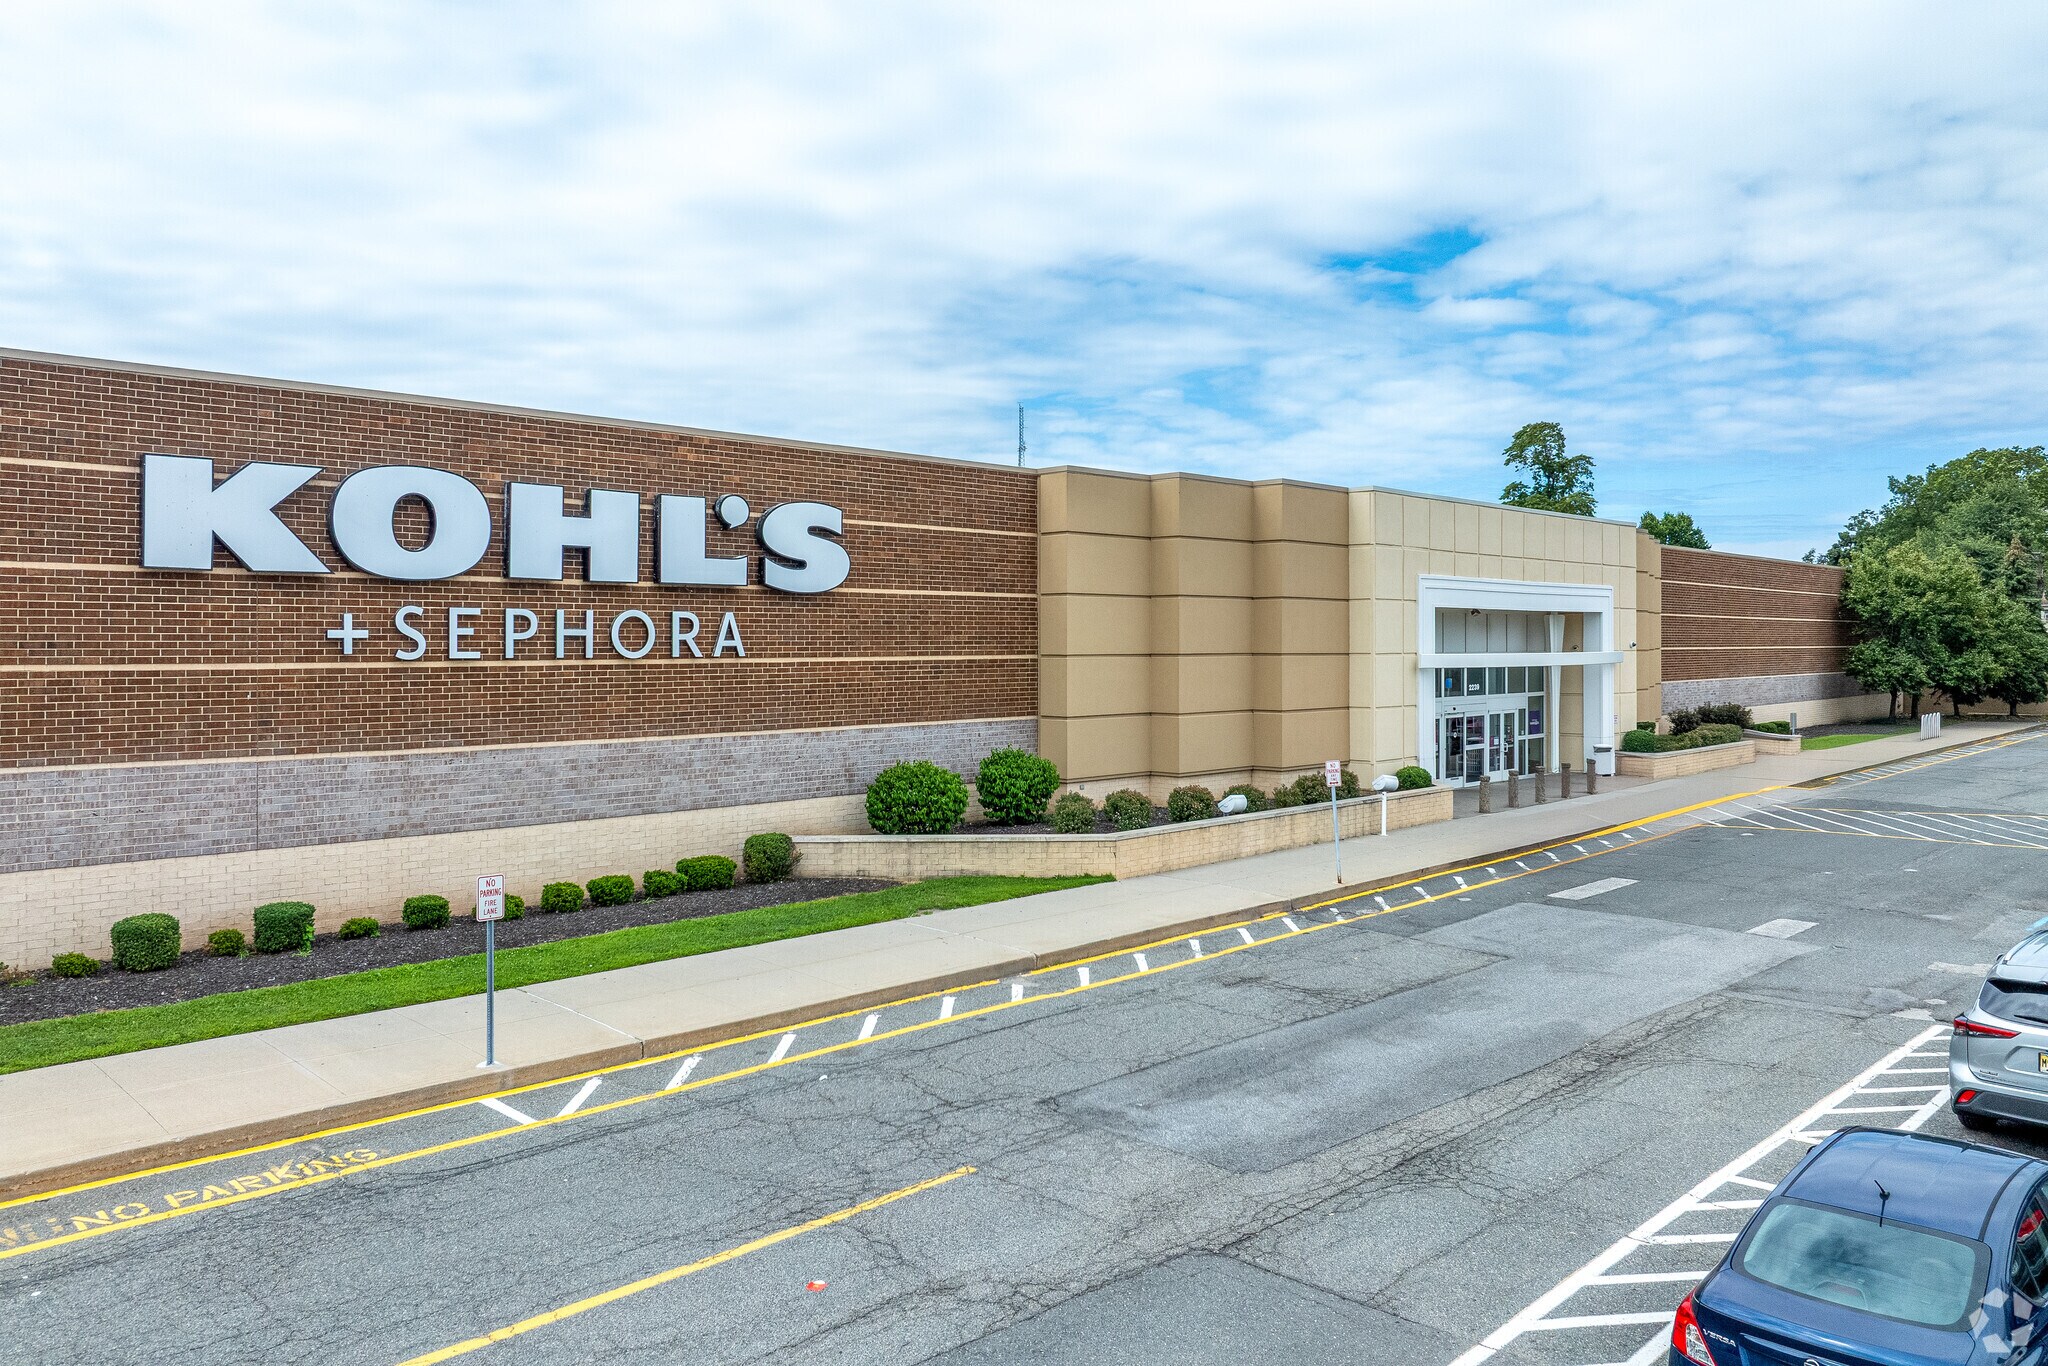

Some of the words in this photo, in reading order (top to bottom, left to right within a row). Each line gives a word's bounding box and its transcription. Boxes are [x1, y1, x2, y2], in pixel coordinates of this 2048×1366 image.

[140, 453, 852, 594] KOHL'S
[394, 604, 747, 661] SEPHORA
[485, 878, 496, 888] NO
[480, 887, 502, 898] PARKING
[484, 899, 497, 907] FIRE
[483, 907, 498, 916] LANE
[70, 1202, 150, 1231] NO
[163, 1148, 378, 1208] PARKING
[1702, 1328, 1737, 1348] VERSA
